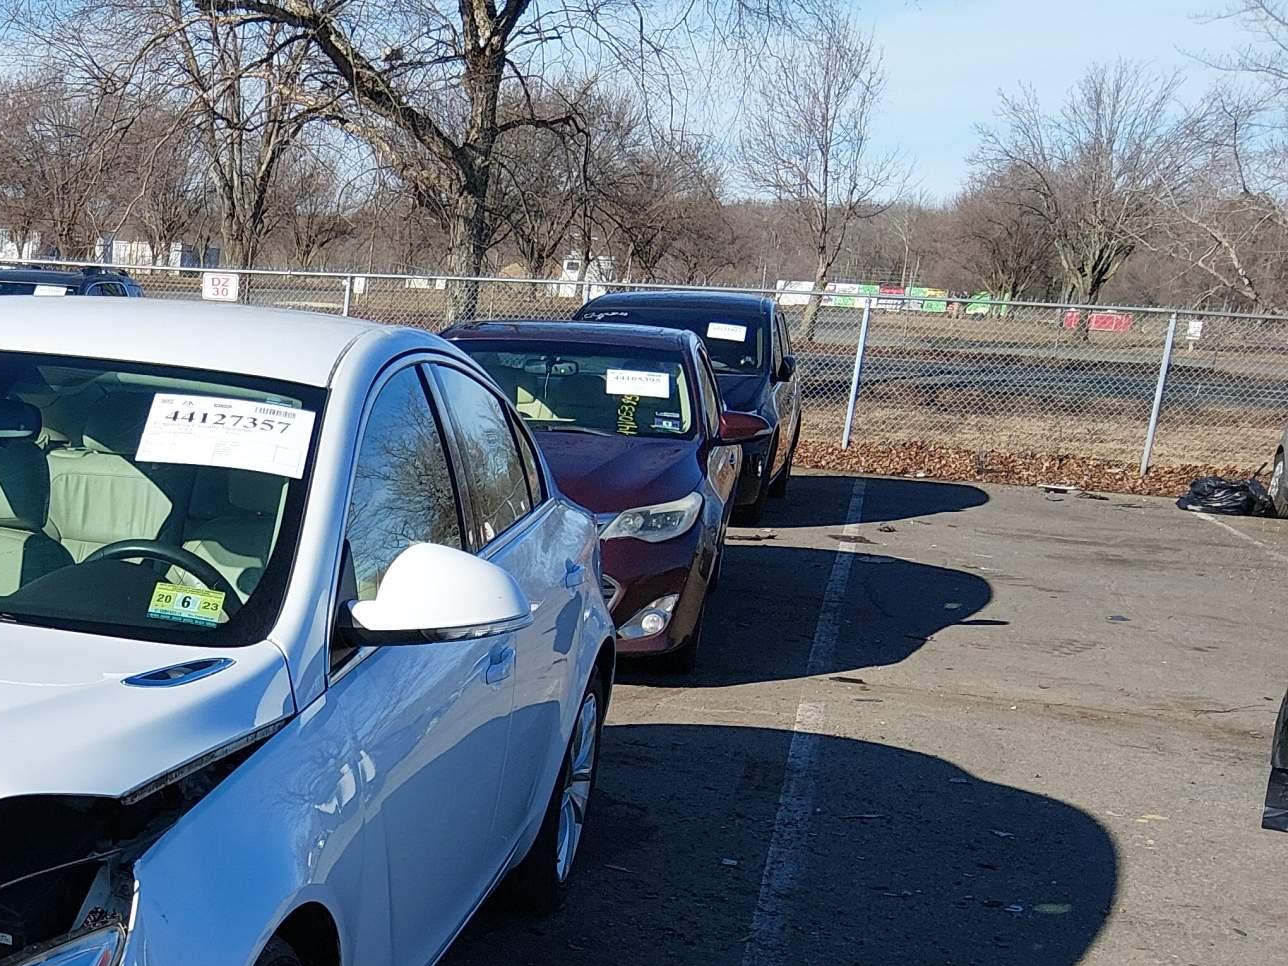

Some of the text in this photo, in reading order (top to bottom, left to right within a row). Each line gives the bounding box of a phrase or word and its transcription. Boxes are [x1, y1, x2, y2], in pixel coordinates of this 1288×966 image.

[212, 277, 230, 287] DZ
[212, 287, 228, 297] 30
[165, 410, 291, 434] 44127357
[156, 593, 219, 611] 20 6 23
